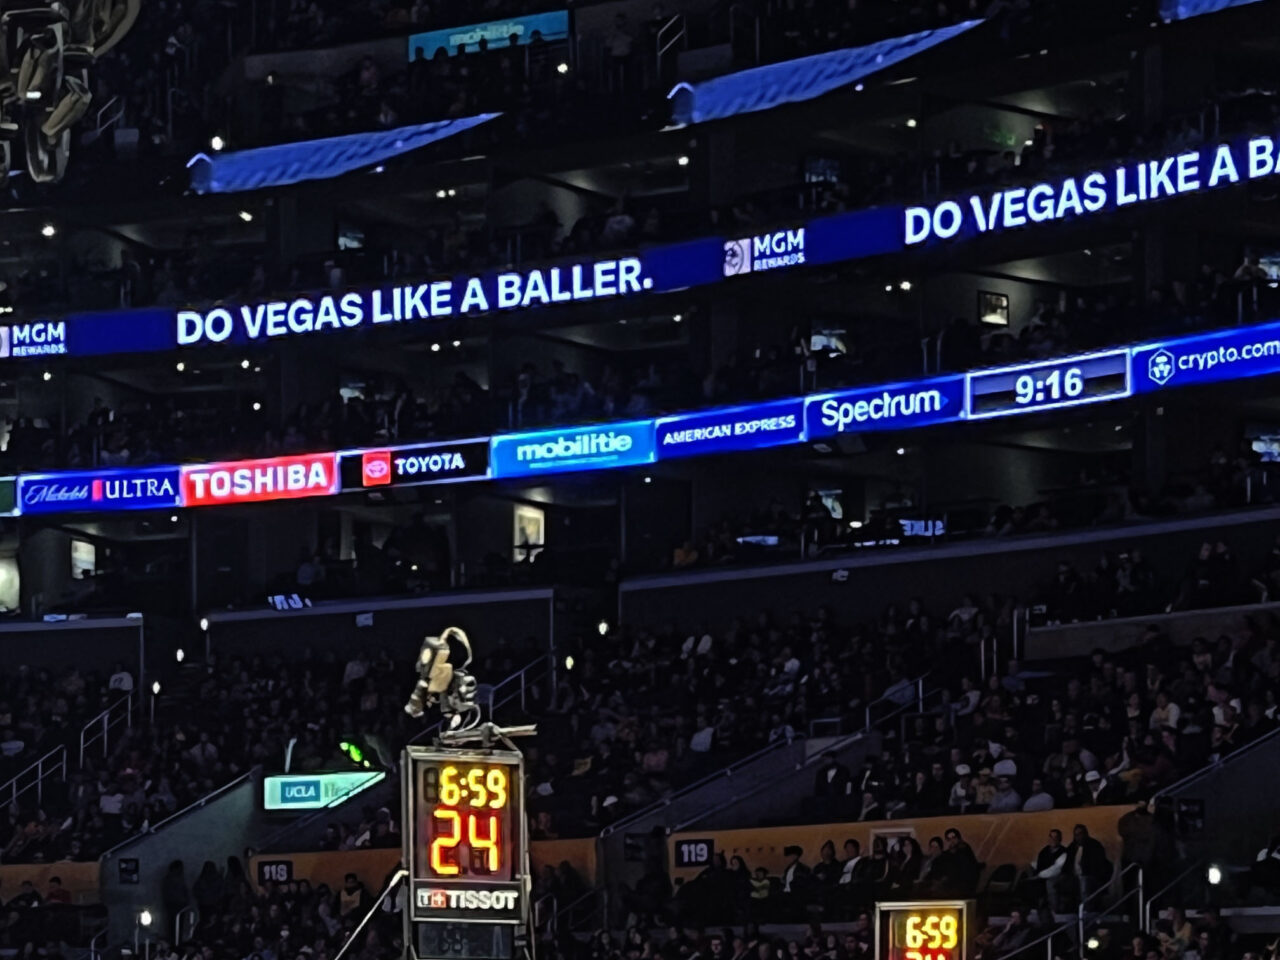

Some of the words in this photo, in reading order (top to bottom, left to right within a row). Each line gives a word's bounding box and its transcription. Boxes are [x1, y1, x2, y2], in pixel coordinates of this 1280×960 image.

[905, 207, 962, 245] DO
[970, 177, 1107, 232] VEGAS
[1116, 152, 1200, 205] LIKE
[1208, 145, 1239, 187] A
[1248, 137, 1280, 179] B
[753, 229, 805, 259] MGM
[177, 309, 233, 345] DO
[241, 295, 363, 338] VEGAS
[372, 281, 452, 324] LIKE
[460, 278, 489, 313] A
[497, 258, 653, 308] BALLER.
[13, 322, 65, 344] MGM
[13, 345, 67, 356] REWARDS
[1178, 340, 1280, 370] crypto.com
[1014, 368, 1083, 405] 9:16
[818, 391, 936, 432] Spectrum
[663, 424, 732, 446] AMERICAN
[734, 414, 797, 436] EXPRESS
[517, 431, 632, 461] mobilitie
[191, 461, 328, 497] TOSHIBA
[394, 453, 466, 477] TOYOTA
[105, 478, 175, 499] ULTRA
[285, 785, 317, 798] UCLA
[439, 765, 506, 809] 6:59
[430, 809, 498, 875] 24
[680, 842, 709, 863] 119
[263, 864, 288, 881] 118
[448, 889, 519, 910] TISSOT
[905, 916, 958, 949] 6:59
